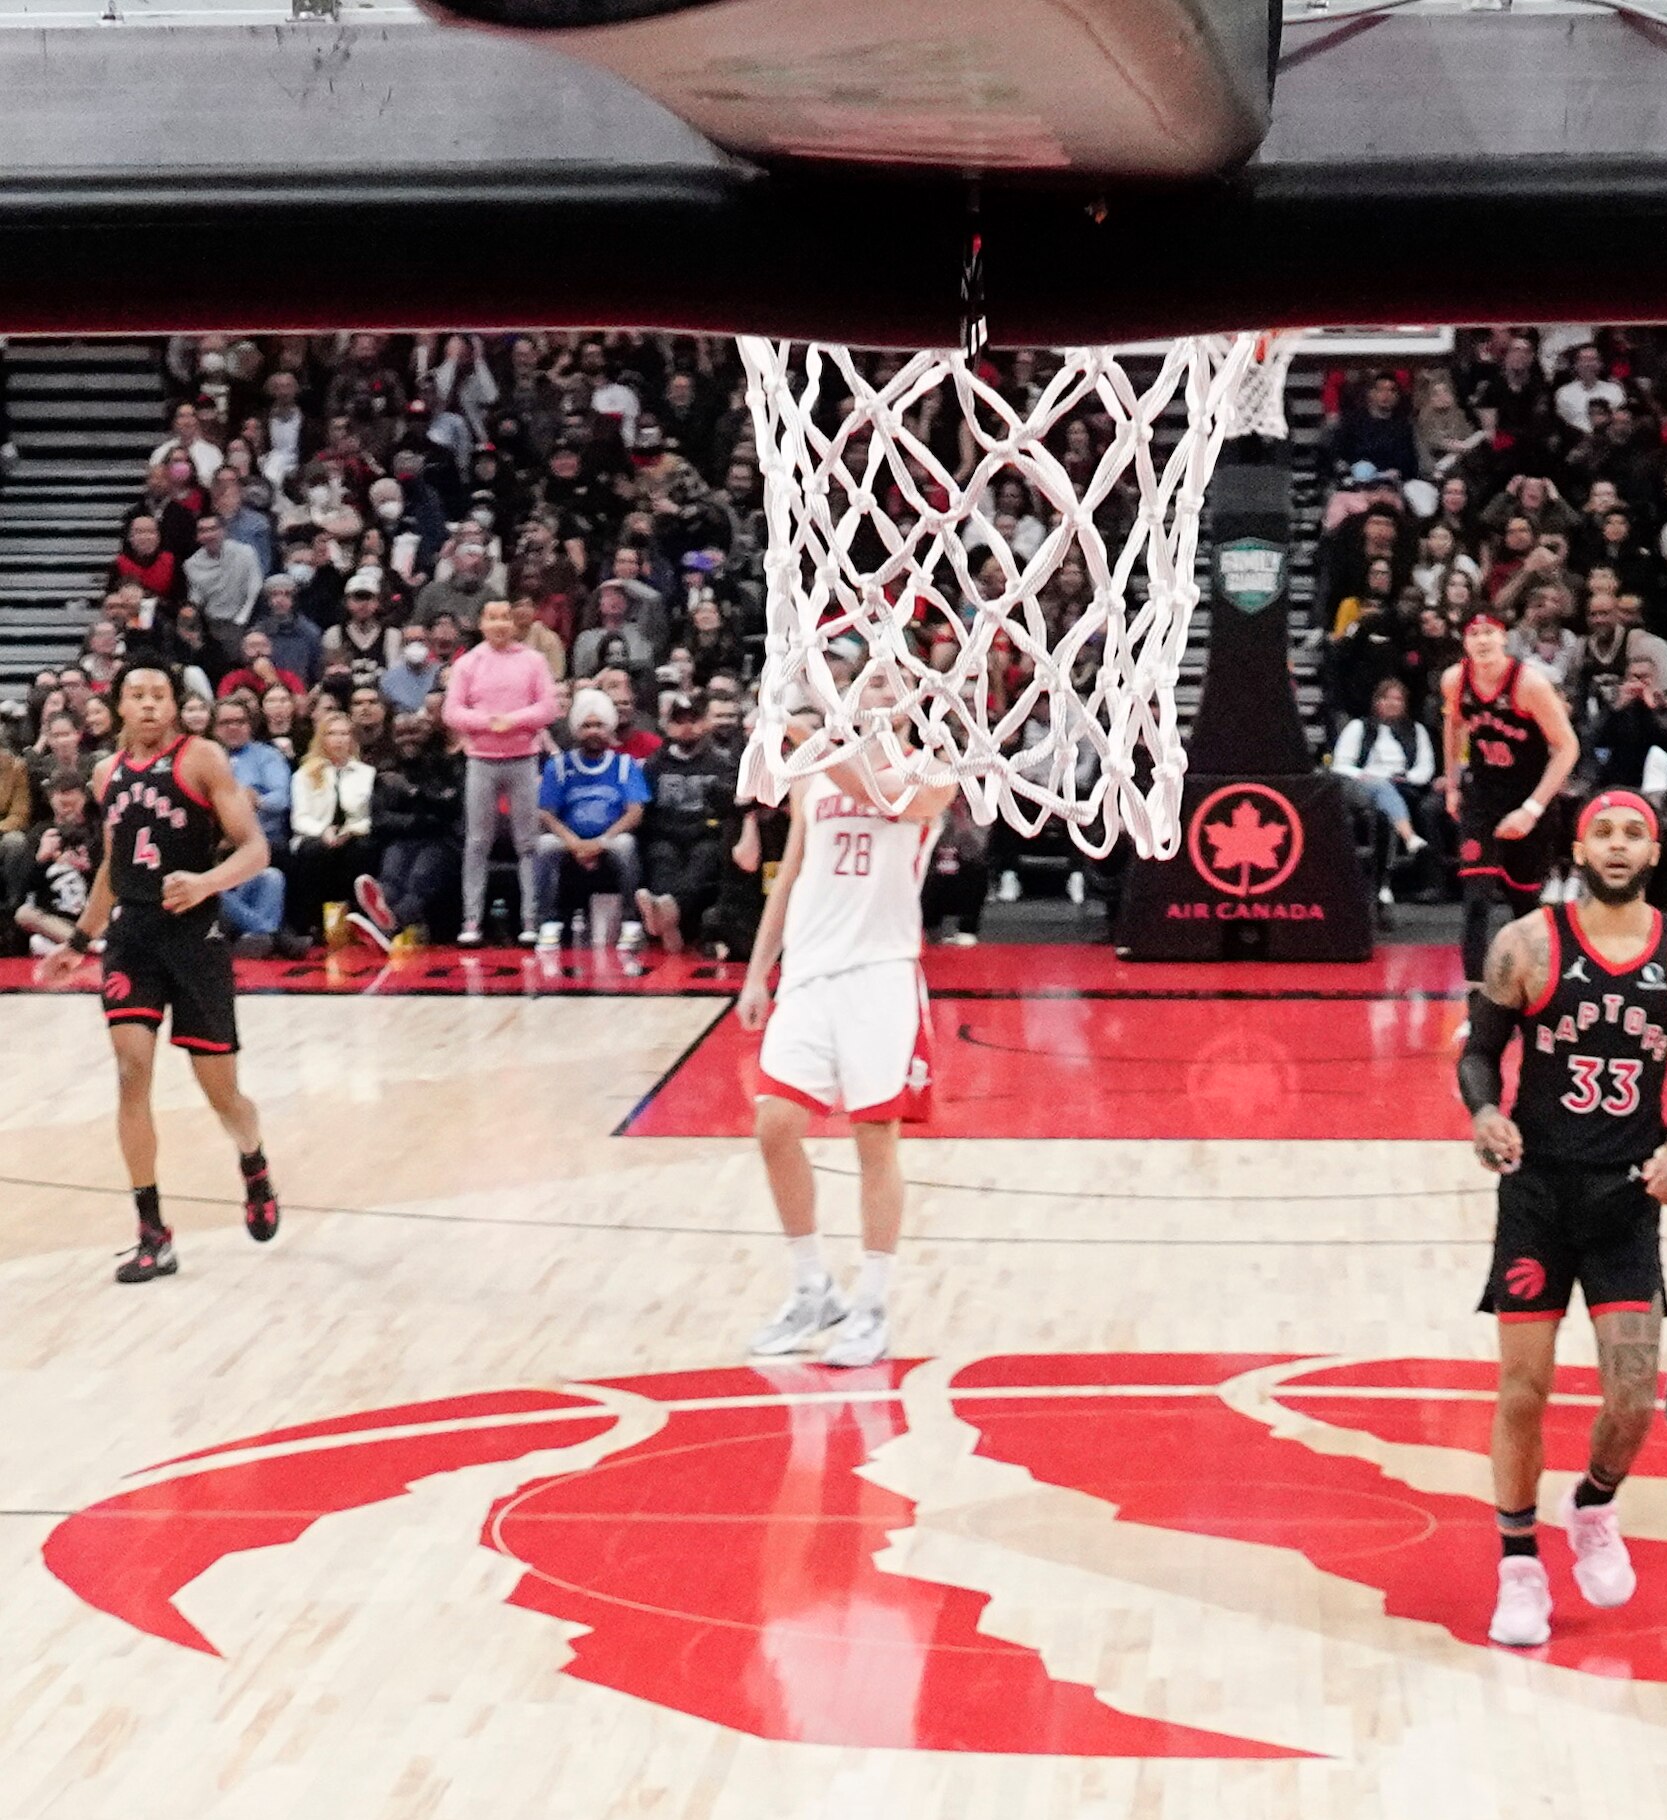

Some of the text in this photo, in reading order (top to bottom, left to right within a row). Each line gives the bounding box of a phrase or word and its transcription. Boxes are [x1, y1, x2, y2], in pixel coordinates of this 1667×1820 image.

[132, 827, 161, 869] 4
[833, 832, 872, 876] 28
[1167, 903, 1326, 921] AIR CANADA
[1560, 1054, 1644, 1117] 33
